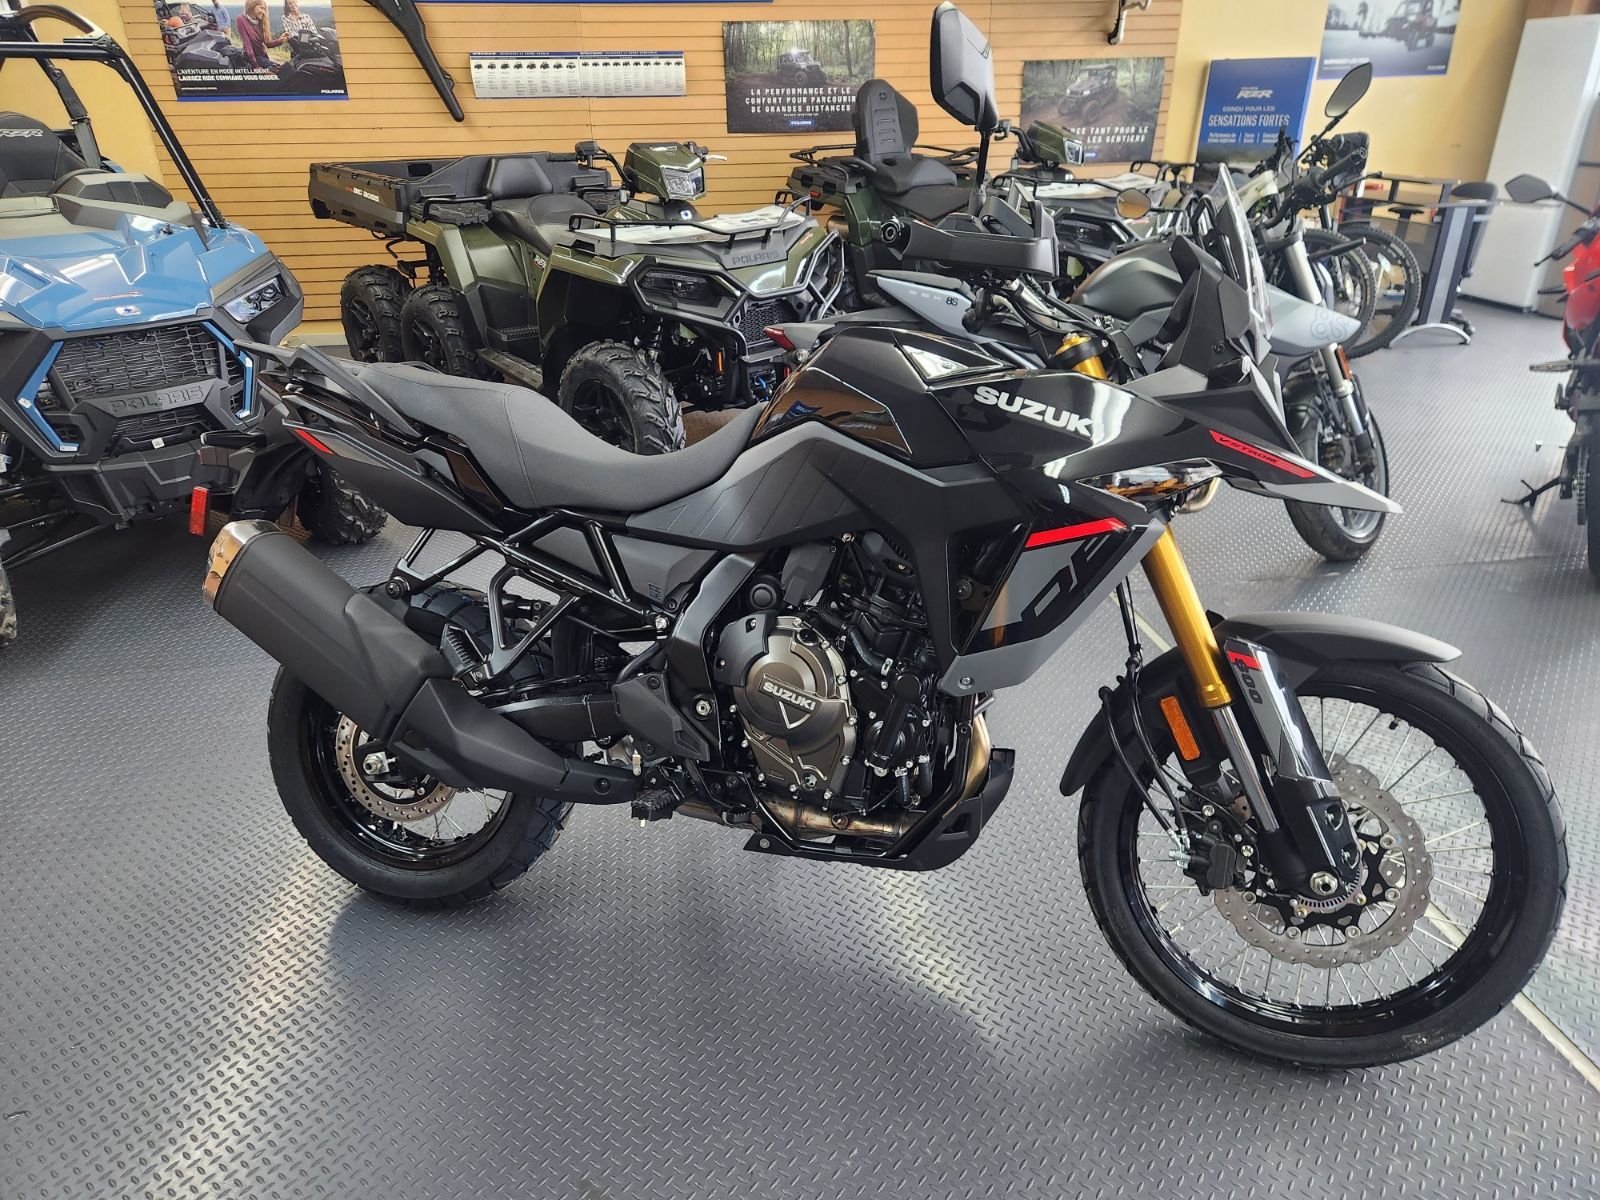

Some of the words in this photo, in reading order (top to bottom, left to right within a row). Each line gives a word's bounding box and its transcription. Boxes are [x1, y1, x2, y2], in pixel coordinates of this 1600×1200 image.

[750, 88, 761, 96] LA
[765, 87, 824, 95] PERFORMANCE
[827, 87, 838, 95] ET
[841, 86, 851, 94] LE
[745, 97, 782, 105] CONFORT
[786, 96, 807, 104] POUR
[811, 95, 856, 104] PARCOURIR
[751, 105, 761, 113] DE
[765, 105, 802, 113] GRANDES
[806, 104, 851, 112] DISTANCES
[1208, 114, 1257, 127] SENSATIONS
[1258, 113, 1290, 127] FORTES
[1090, 126, 1111, 135] TANT
[1114, 126, 1136, 134] POUR
[1138, 125, 1149, 134] LE
[1087, 135, 1102, 144] LES
[1105, 134, 1146, 144] SENTIERS
[732, 250, 780, 265] POLARIS
[945, 296, 959, 307] 8S
[109, 385, 204, 411] POLARIS
[763, 681, 816, 711] SUZUKI
